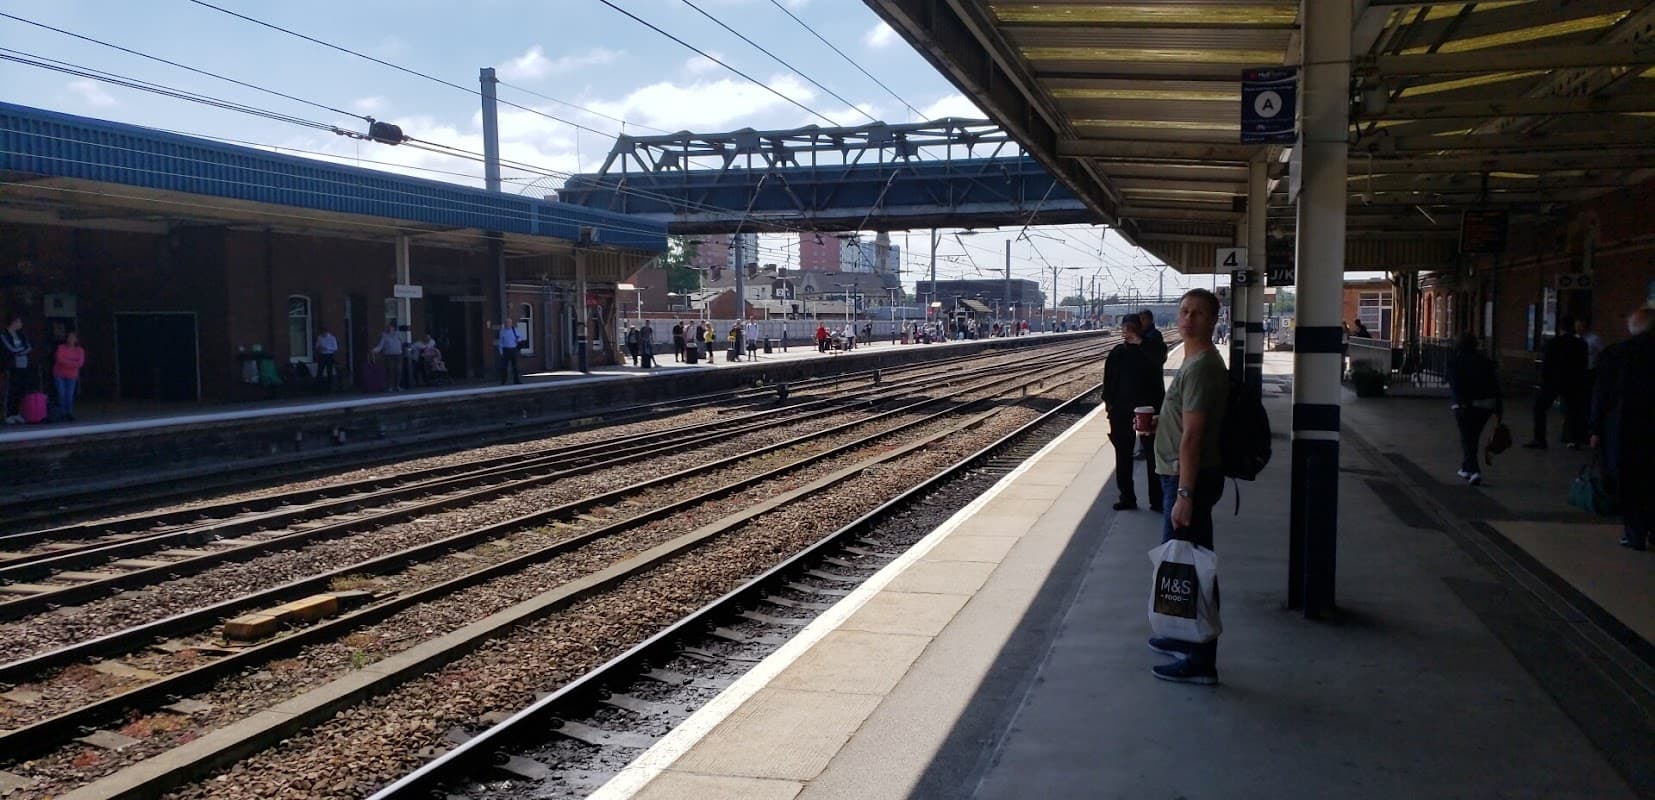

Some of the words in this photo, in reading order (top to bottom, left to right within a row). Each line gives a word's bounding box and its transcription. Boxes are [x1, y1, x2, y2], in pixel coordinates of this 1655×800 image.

[1262, 98, 1274, 111] A
[1224, 252, 1238, 266] 4
[1237, 270, 1246, 282] 5
[1161, 576, 1191, 594] M&S
